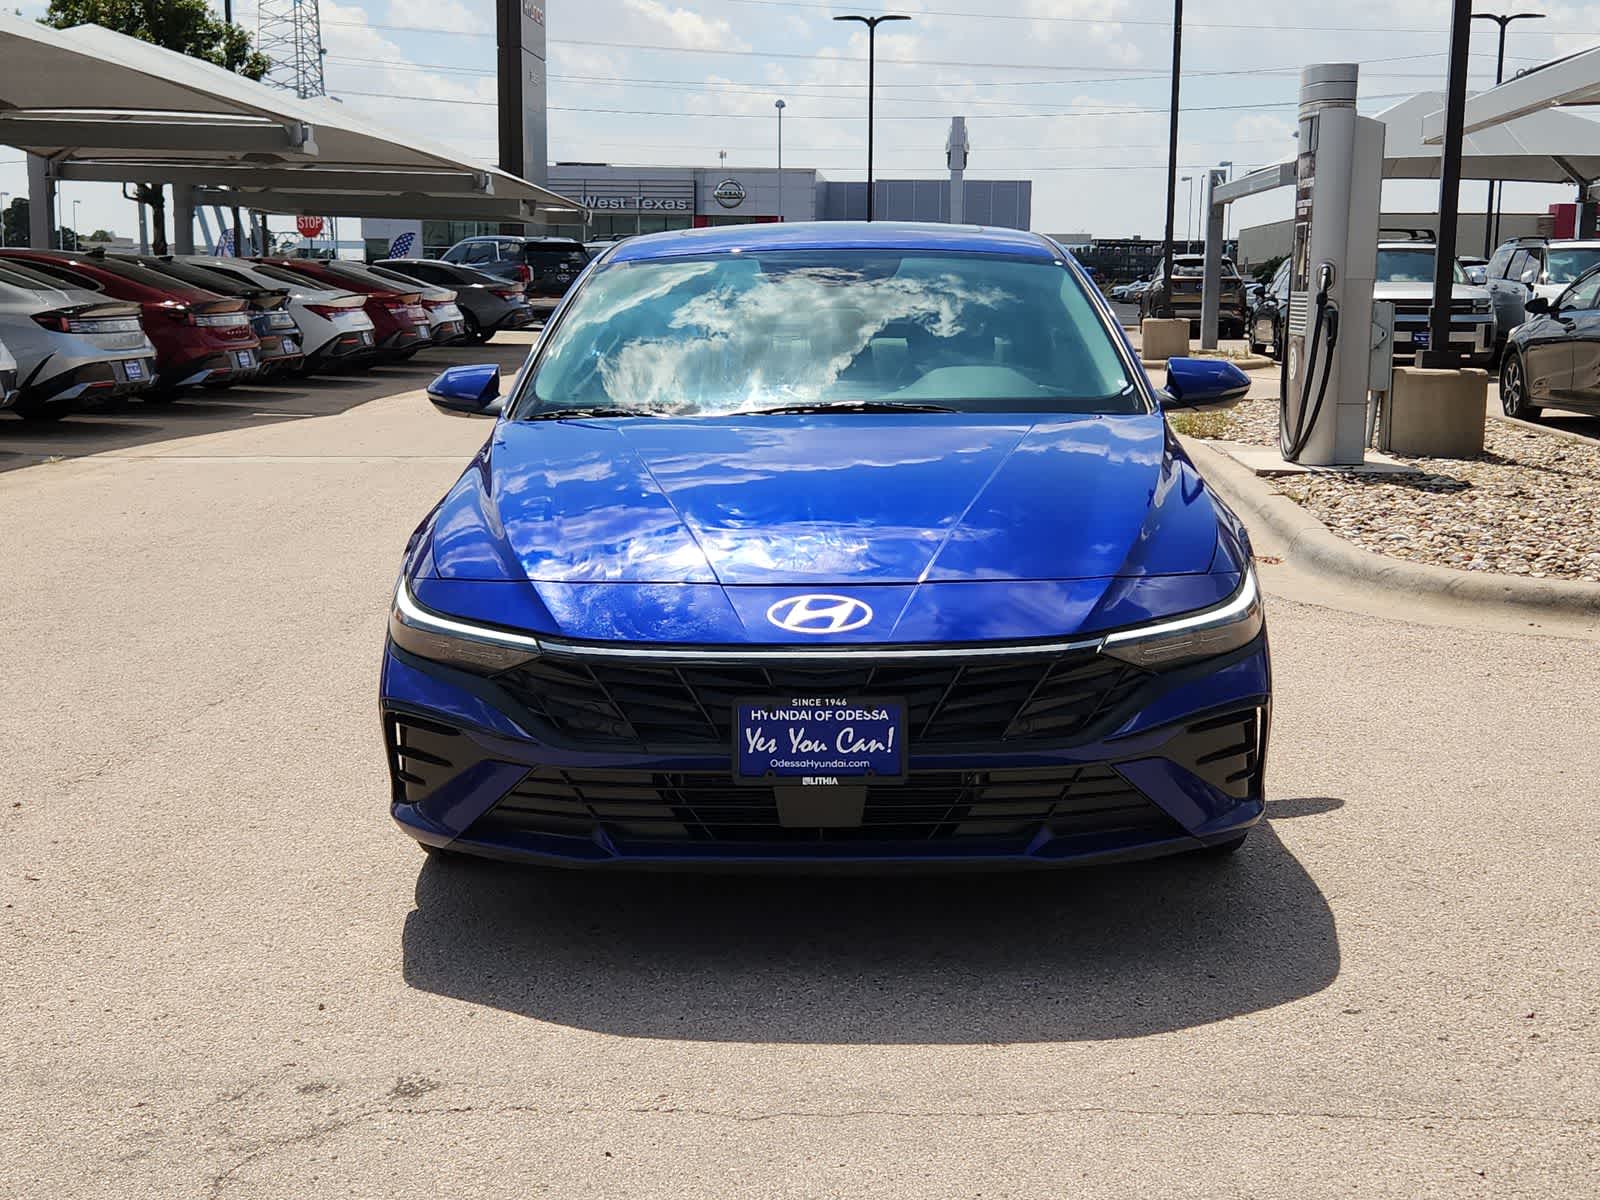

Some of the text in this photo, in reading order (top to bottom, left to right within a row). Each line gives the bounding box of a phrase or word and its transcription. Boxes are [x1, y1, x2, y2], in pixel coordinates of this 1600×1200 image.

[580, 195, 687, 210] West Texas
[298, 215, 322, 229] STOP
[791, 698, 848, 707] SINCE 1946
[751, 709, 889, 721] HYUNDAI OF ODESSA
[745, 726, 895, 754] Yes You Can!
[770, 759, 870, 770] OdessaHyundai.com
[810, 776, 839, 785] LITHIA
